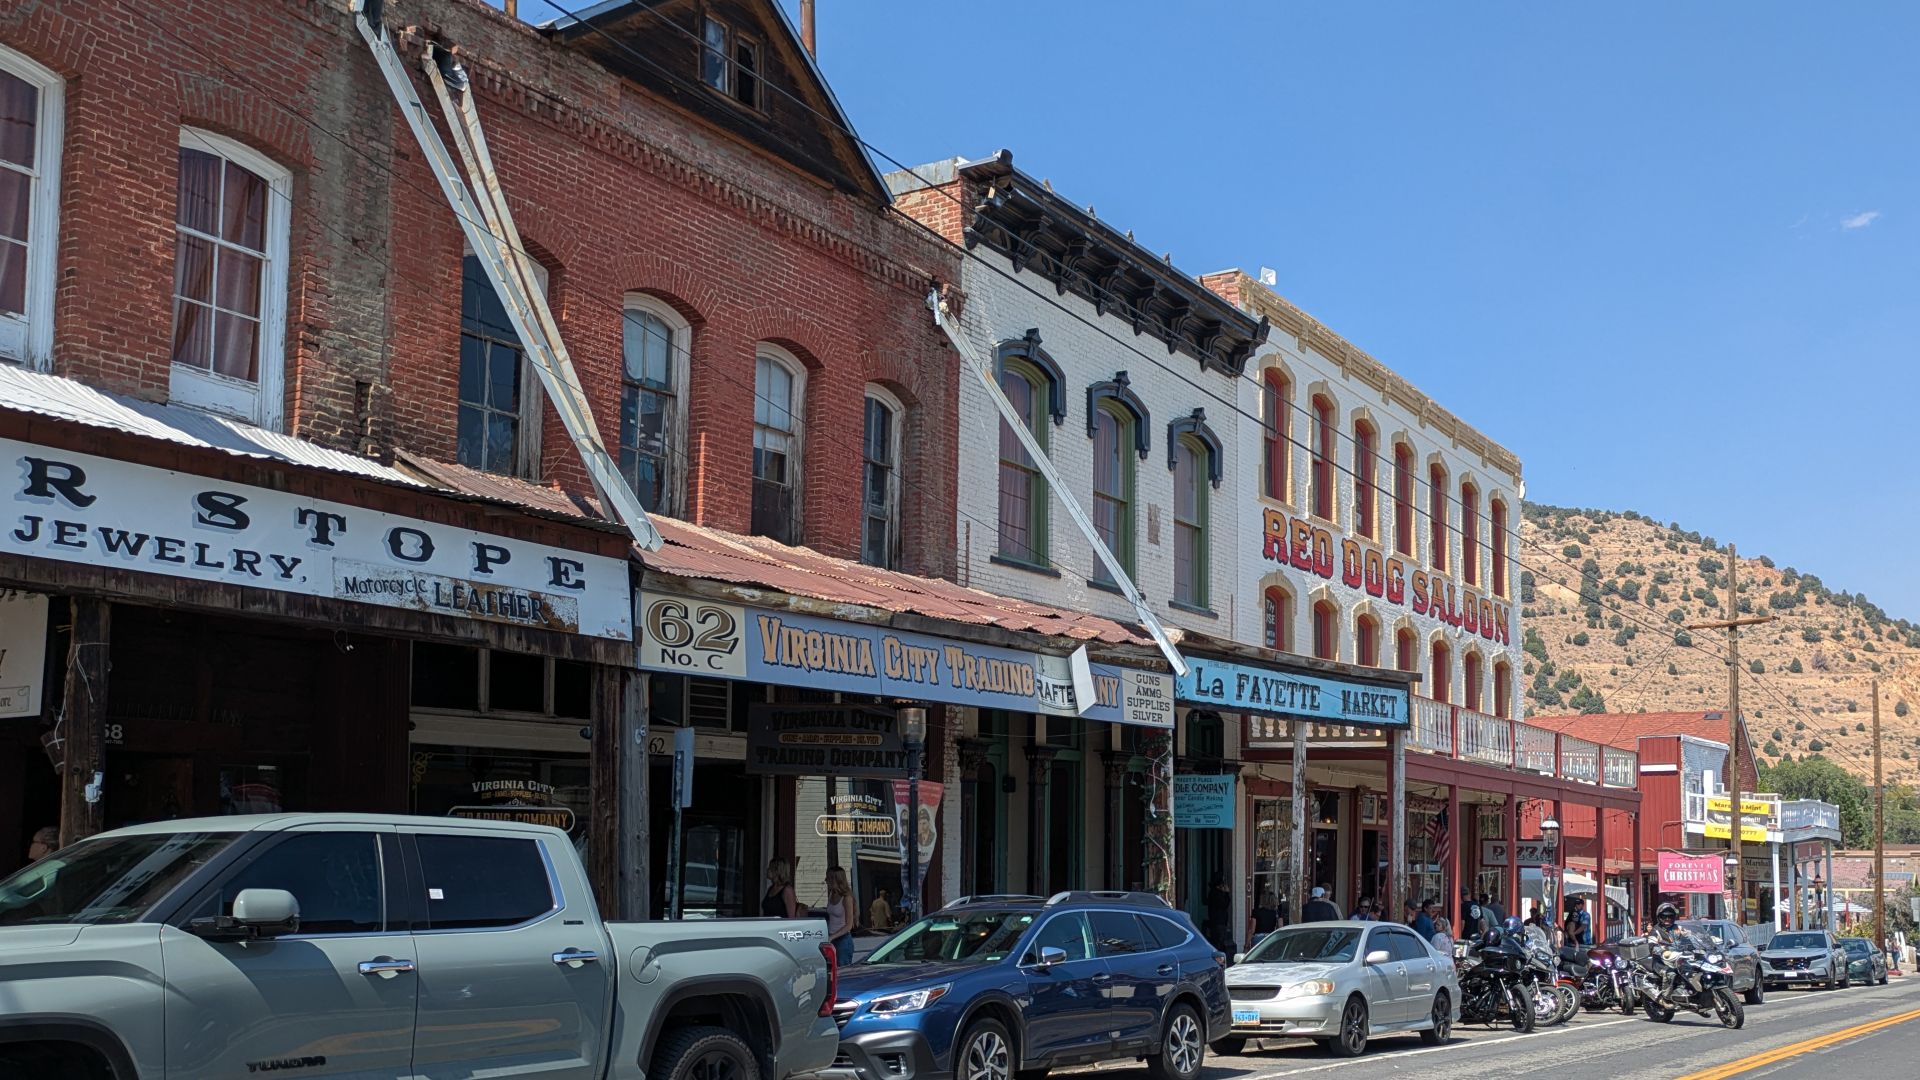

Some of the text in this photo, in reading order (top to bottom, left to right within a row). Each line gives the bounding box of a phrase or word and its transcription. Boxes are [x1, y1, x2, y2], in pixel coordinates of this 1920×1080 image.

[13, 515, 307, 582] JEWELRY,
[1263, 507, 1510, 646] RED DOG SALOON
[344, 576, 428, 595] Motorcycle
[646, 599, 739, 654] 62
[661, 648, 724, 670] No. C
[1136, 674, 1160, 686] GUNS
[1136, 686, 1162, 698] AMMO
[1195, 666, 1397, 718] La FAYETTE MARKET
[1127, 697, 1170, 712] SUPPLIES
[1133, 710, 1163, 723] SILVER
[649, 737, 666, 754] 62
[1192, 782, 1229, 795] COMPANY
[821, 820, 891, 833] TRADING COMPANY
[1493, 846, 1554, 861] PZZA
[1745, 859, 1773, 867] Marshal
[1664, 869, 1718, 882] CHRISTMAS
[246, 1056, 326, 1072] TUNDRA
